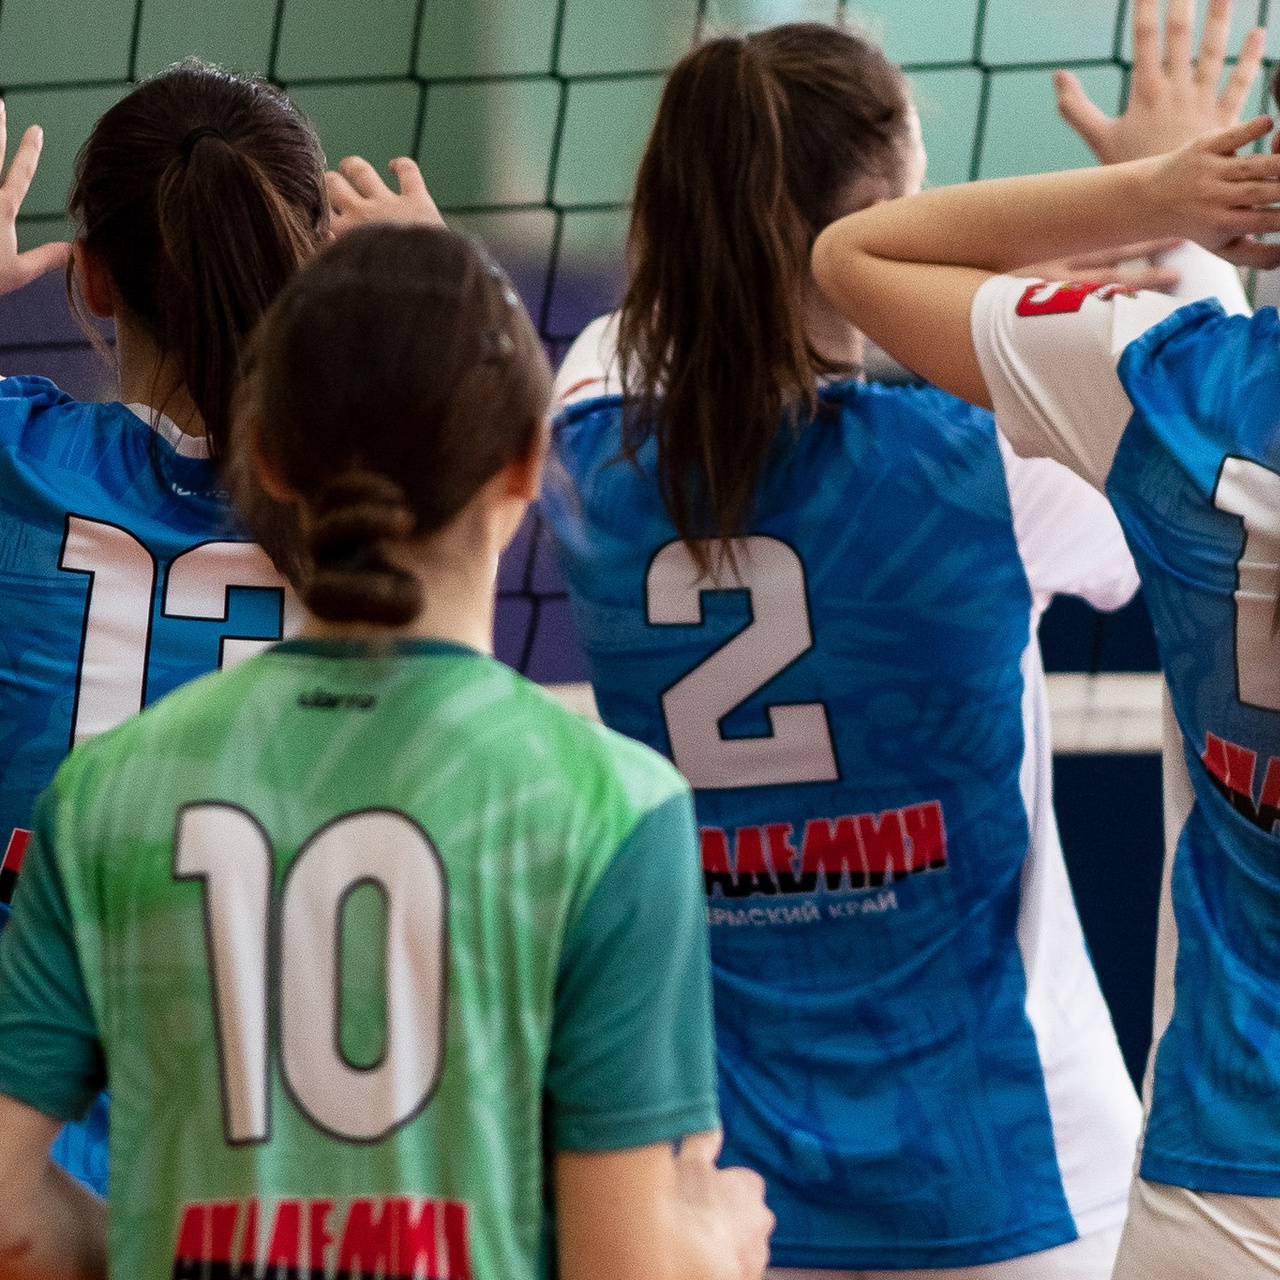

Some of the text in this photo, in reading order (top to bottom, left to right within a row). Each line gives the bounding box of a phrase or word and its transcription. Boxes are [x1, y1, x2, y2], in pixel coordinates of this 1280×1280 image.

[644, 533, 843, 791] 2
[699, 800, 947, 898] АДЕМИЯ
[707, 899, 821, 926] РМСКИЙ
[172, 800, 450, 1146] 10
